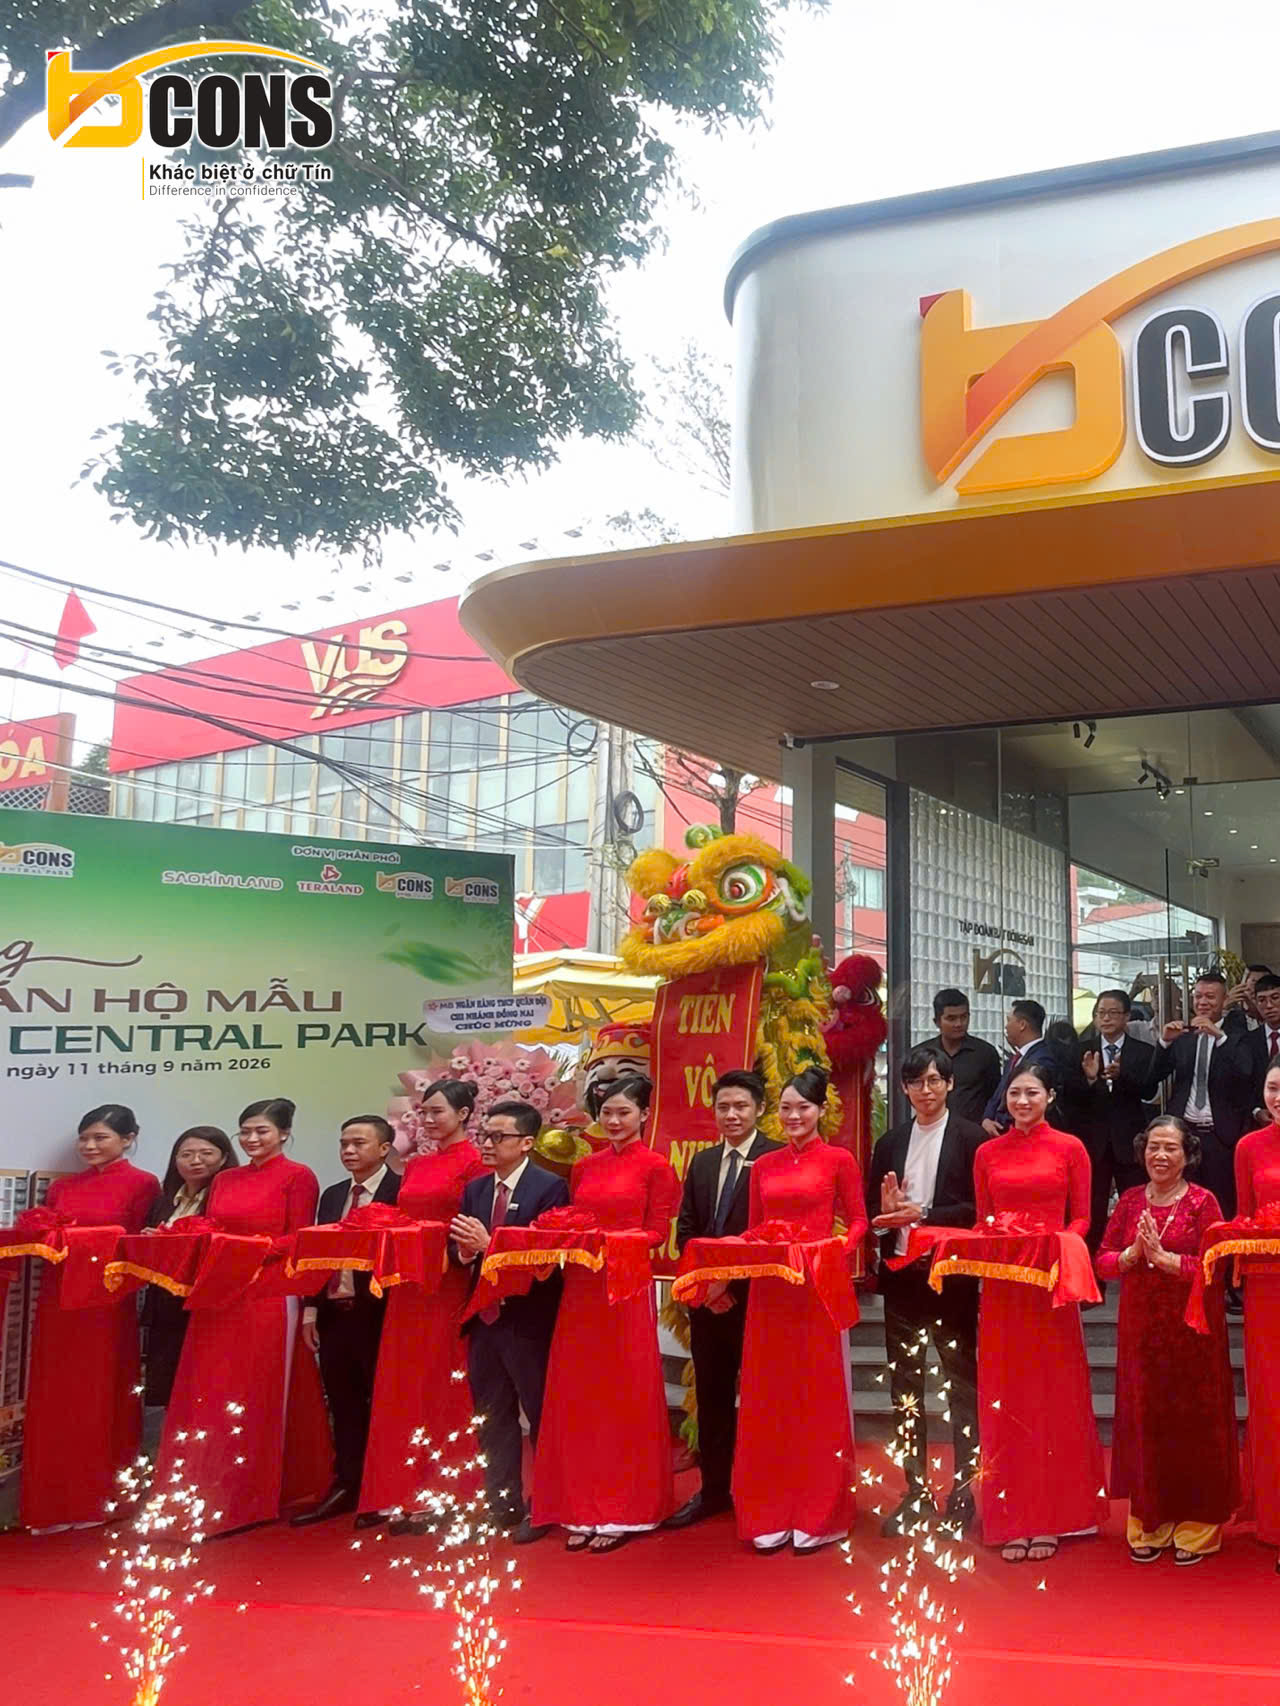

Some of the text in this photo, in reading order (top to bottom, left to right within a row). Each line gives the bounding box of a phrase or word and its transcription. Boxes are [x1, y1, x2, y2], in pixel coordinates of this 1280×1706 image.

[302, 619, 409, 693] VUS
[294, 846, 320, 856] ĐƠN
[322, 848, 335, 860] VỊ
[338, 848, 369, 860] PHÂN
[299, 882, 363, 895] TERALAND
[93, 982, 188, 1020] HỘ
[206, 978, 342, 1013] MẪU
[9, 1021, 428, 1054] CENTRAL PARK
[455, 1021, 491, 1031] CHÚC
[7, 1057, 271, 1080] ngày 11 tháng 9 năm 2026
[684, 1053, 718, 1108] VÔ
